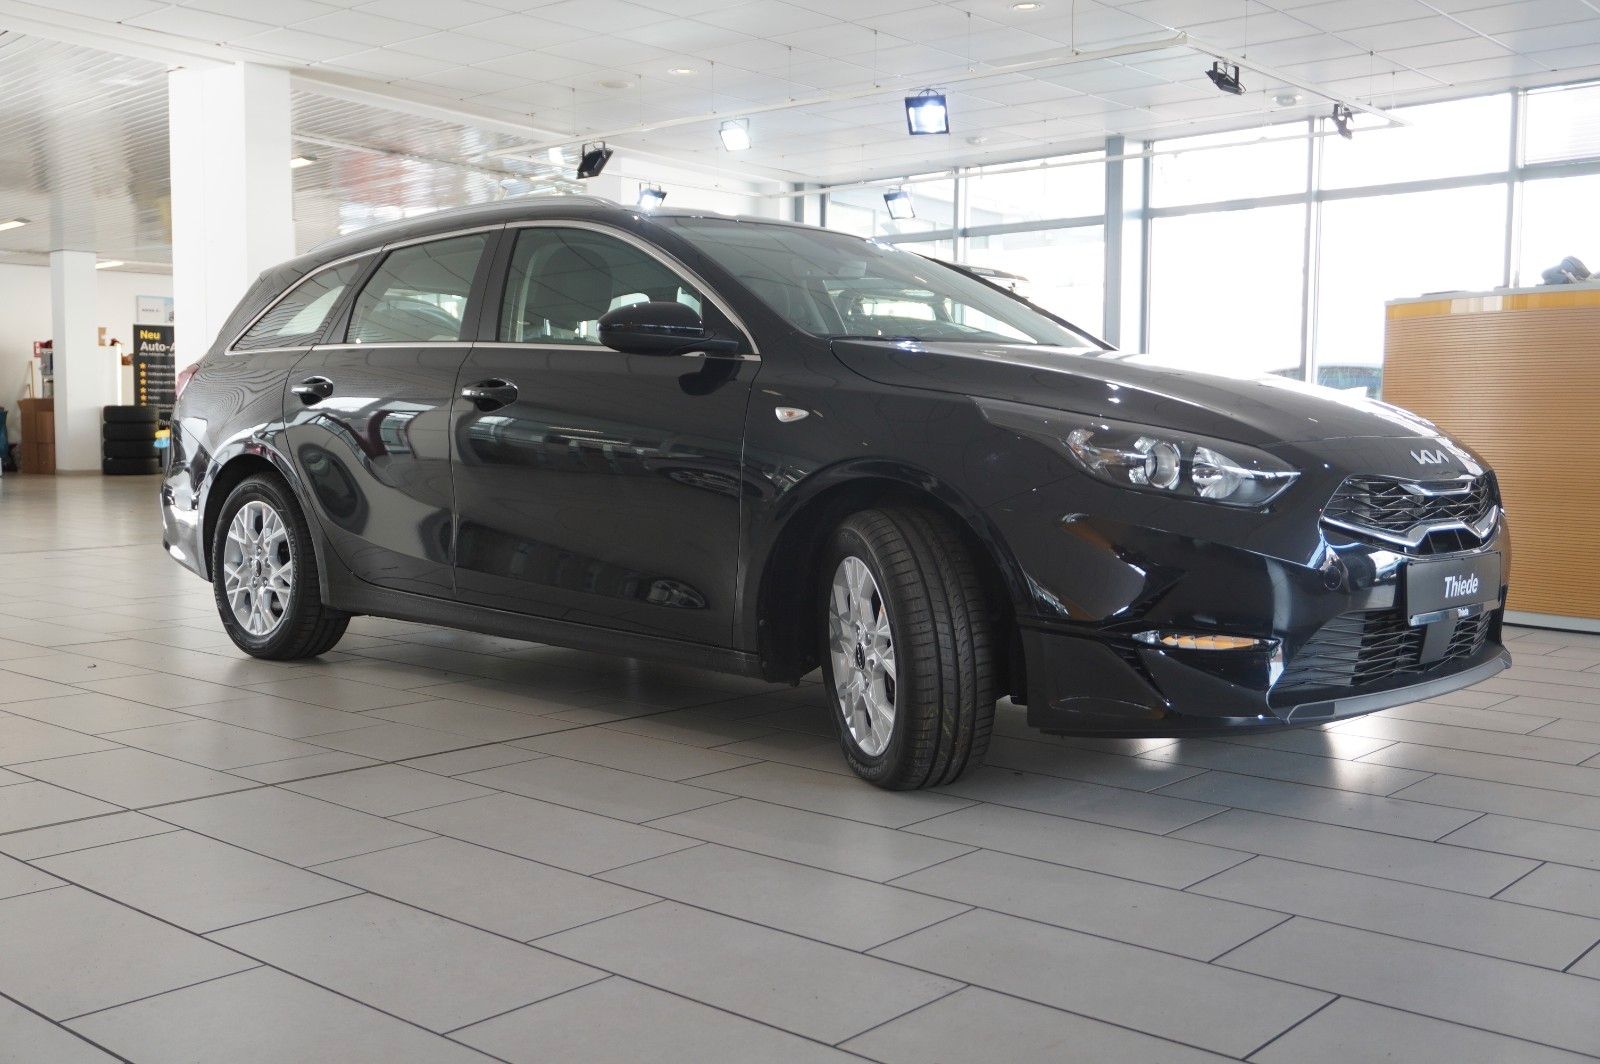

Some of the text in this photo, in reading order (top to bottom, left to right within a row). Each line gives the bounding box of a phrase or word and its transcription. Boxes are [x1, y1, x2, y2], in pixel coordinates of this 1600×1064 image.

[140, 329, 161, 340] Neu
[1410, 449, 1450, 465] KIA
[1444, 572, 1479, 599] Thiede
